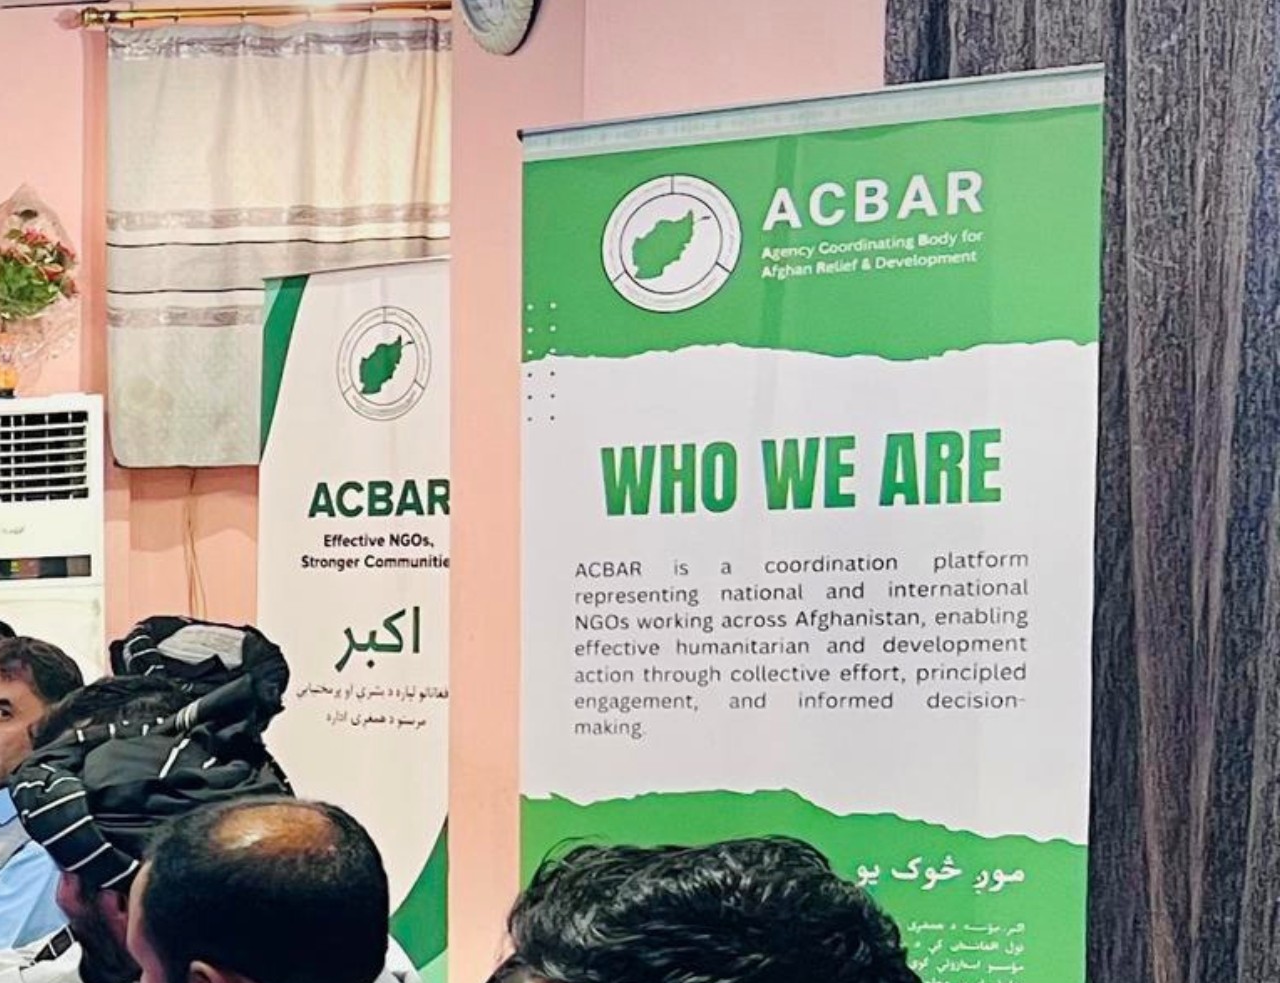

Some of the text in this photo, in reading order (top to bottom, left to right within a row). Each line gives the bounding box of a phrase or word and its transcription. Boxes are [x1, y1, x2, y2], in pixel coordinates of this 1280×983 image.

[761, 170, 985, 232] ACBAR
[761, 227, 984, 264] Agency Coordinating Body for
[761, 250, 977, 283] Afghan Relief & Development
[600, 427, 1003, 517] WHO WE ARE
[308, 479, 450, 518] ACBAR
[323, 533, 434, 549] Effective NGOs,
[301, 554, 450, 572] Stronger Communitie
[574, 551, 1029, 578] ACBAR is a coordination platform
[574, 579, 1029, 608] representing national and international
[574, 607, 1029, 633] NGOs working across Afghanistan, enabling
[574, 635, 1028, 659] effective humanitarian and development
[574, 662, 1028, 687] action through collective effort, principled
[574, 690, 1026, 713] engagement, and informed decision-
[574, 718, 646, 740] making.
